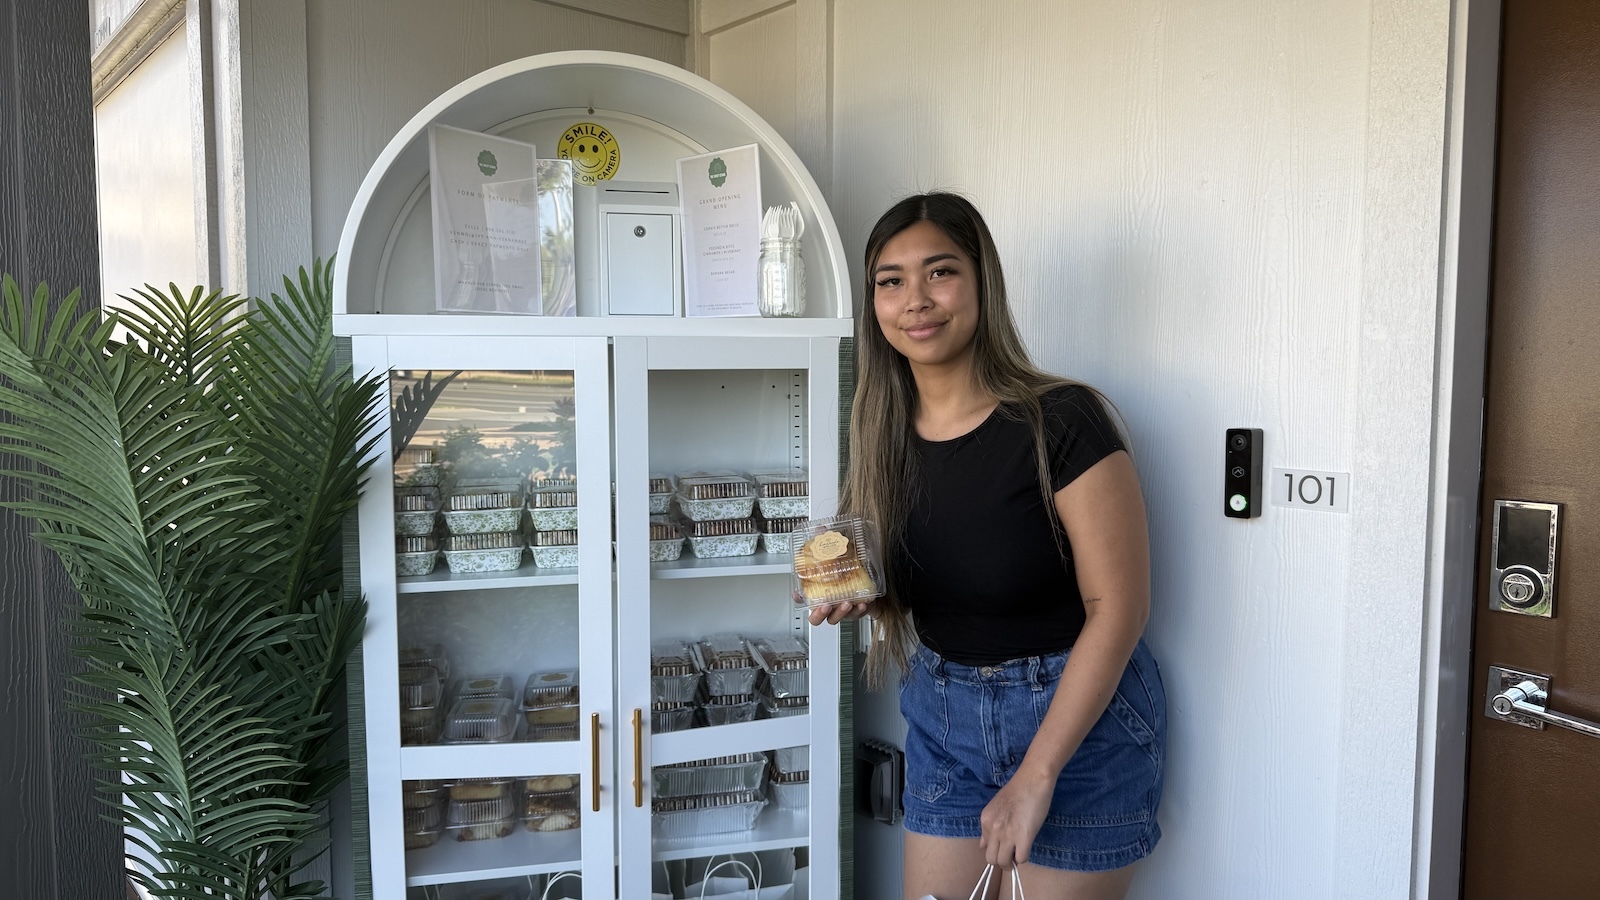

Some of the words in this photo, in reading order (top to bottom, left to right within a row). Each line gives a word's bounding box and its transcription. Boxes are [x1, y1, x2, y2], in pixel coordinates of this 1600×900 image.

[565, 126, 612, 145] SMILE!
[582, 175, 595, 183] ON
[597, 149, 617, 181] CAMERA
[457, 189, 475, 198] FORM
[698, 197, 717, 205] GRAND
[717, 193, 741, 202] OPENING
[1284, 473, 1335, 506] 101
